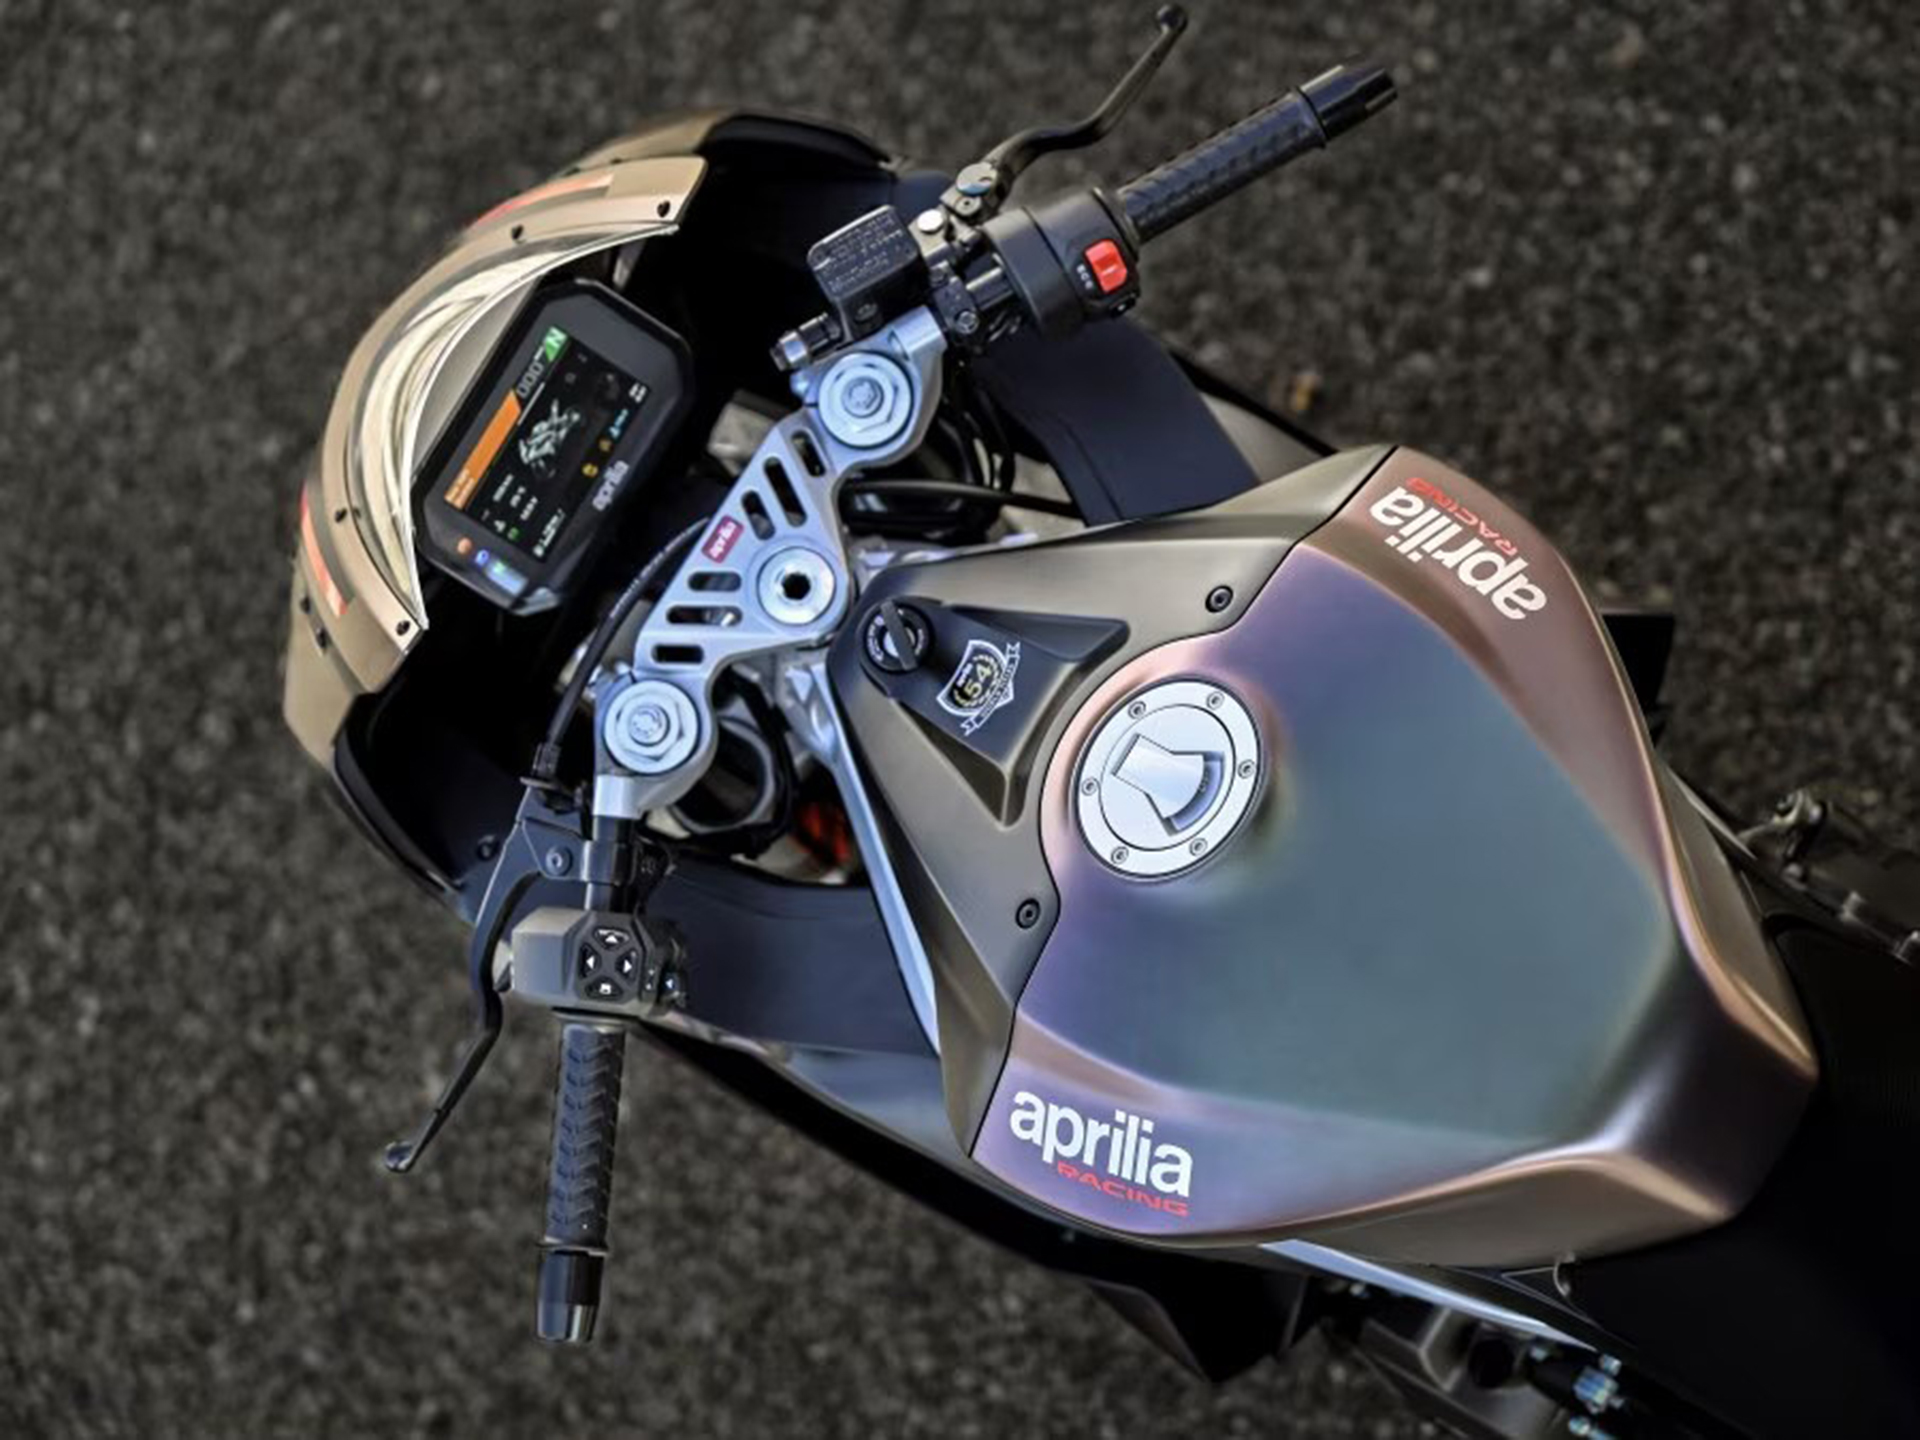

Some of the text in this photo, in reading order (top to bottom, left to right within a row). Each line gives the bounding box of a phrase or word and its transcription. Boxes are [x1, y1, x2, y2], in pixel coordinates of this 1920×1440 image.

[546, 327, 567, 348] N
[593, 461, 629, 510] aprilia
[1405, 477, 1517, 556] RACING
[1369, 486, 1547, 620] aprilia
[964, 663, 992, 698] 54
[1010, 1091, 1193, 1197] aprilia
[1057, 1160, 1189, 1217] RACING
